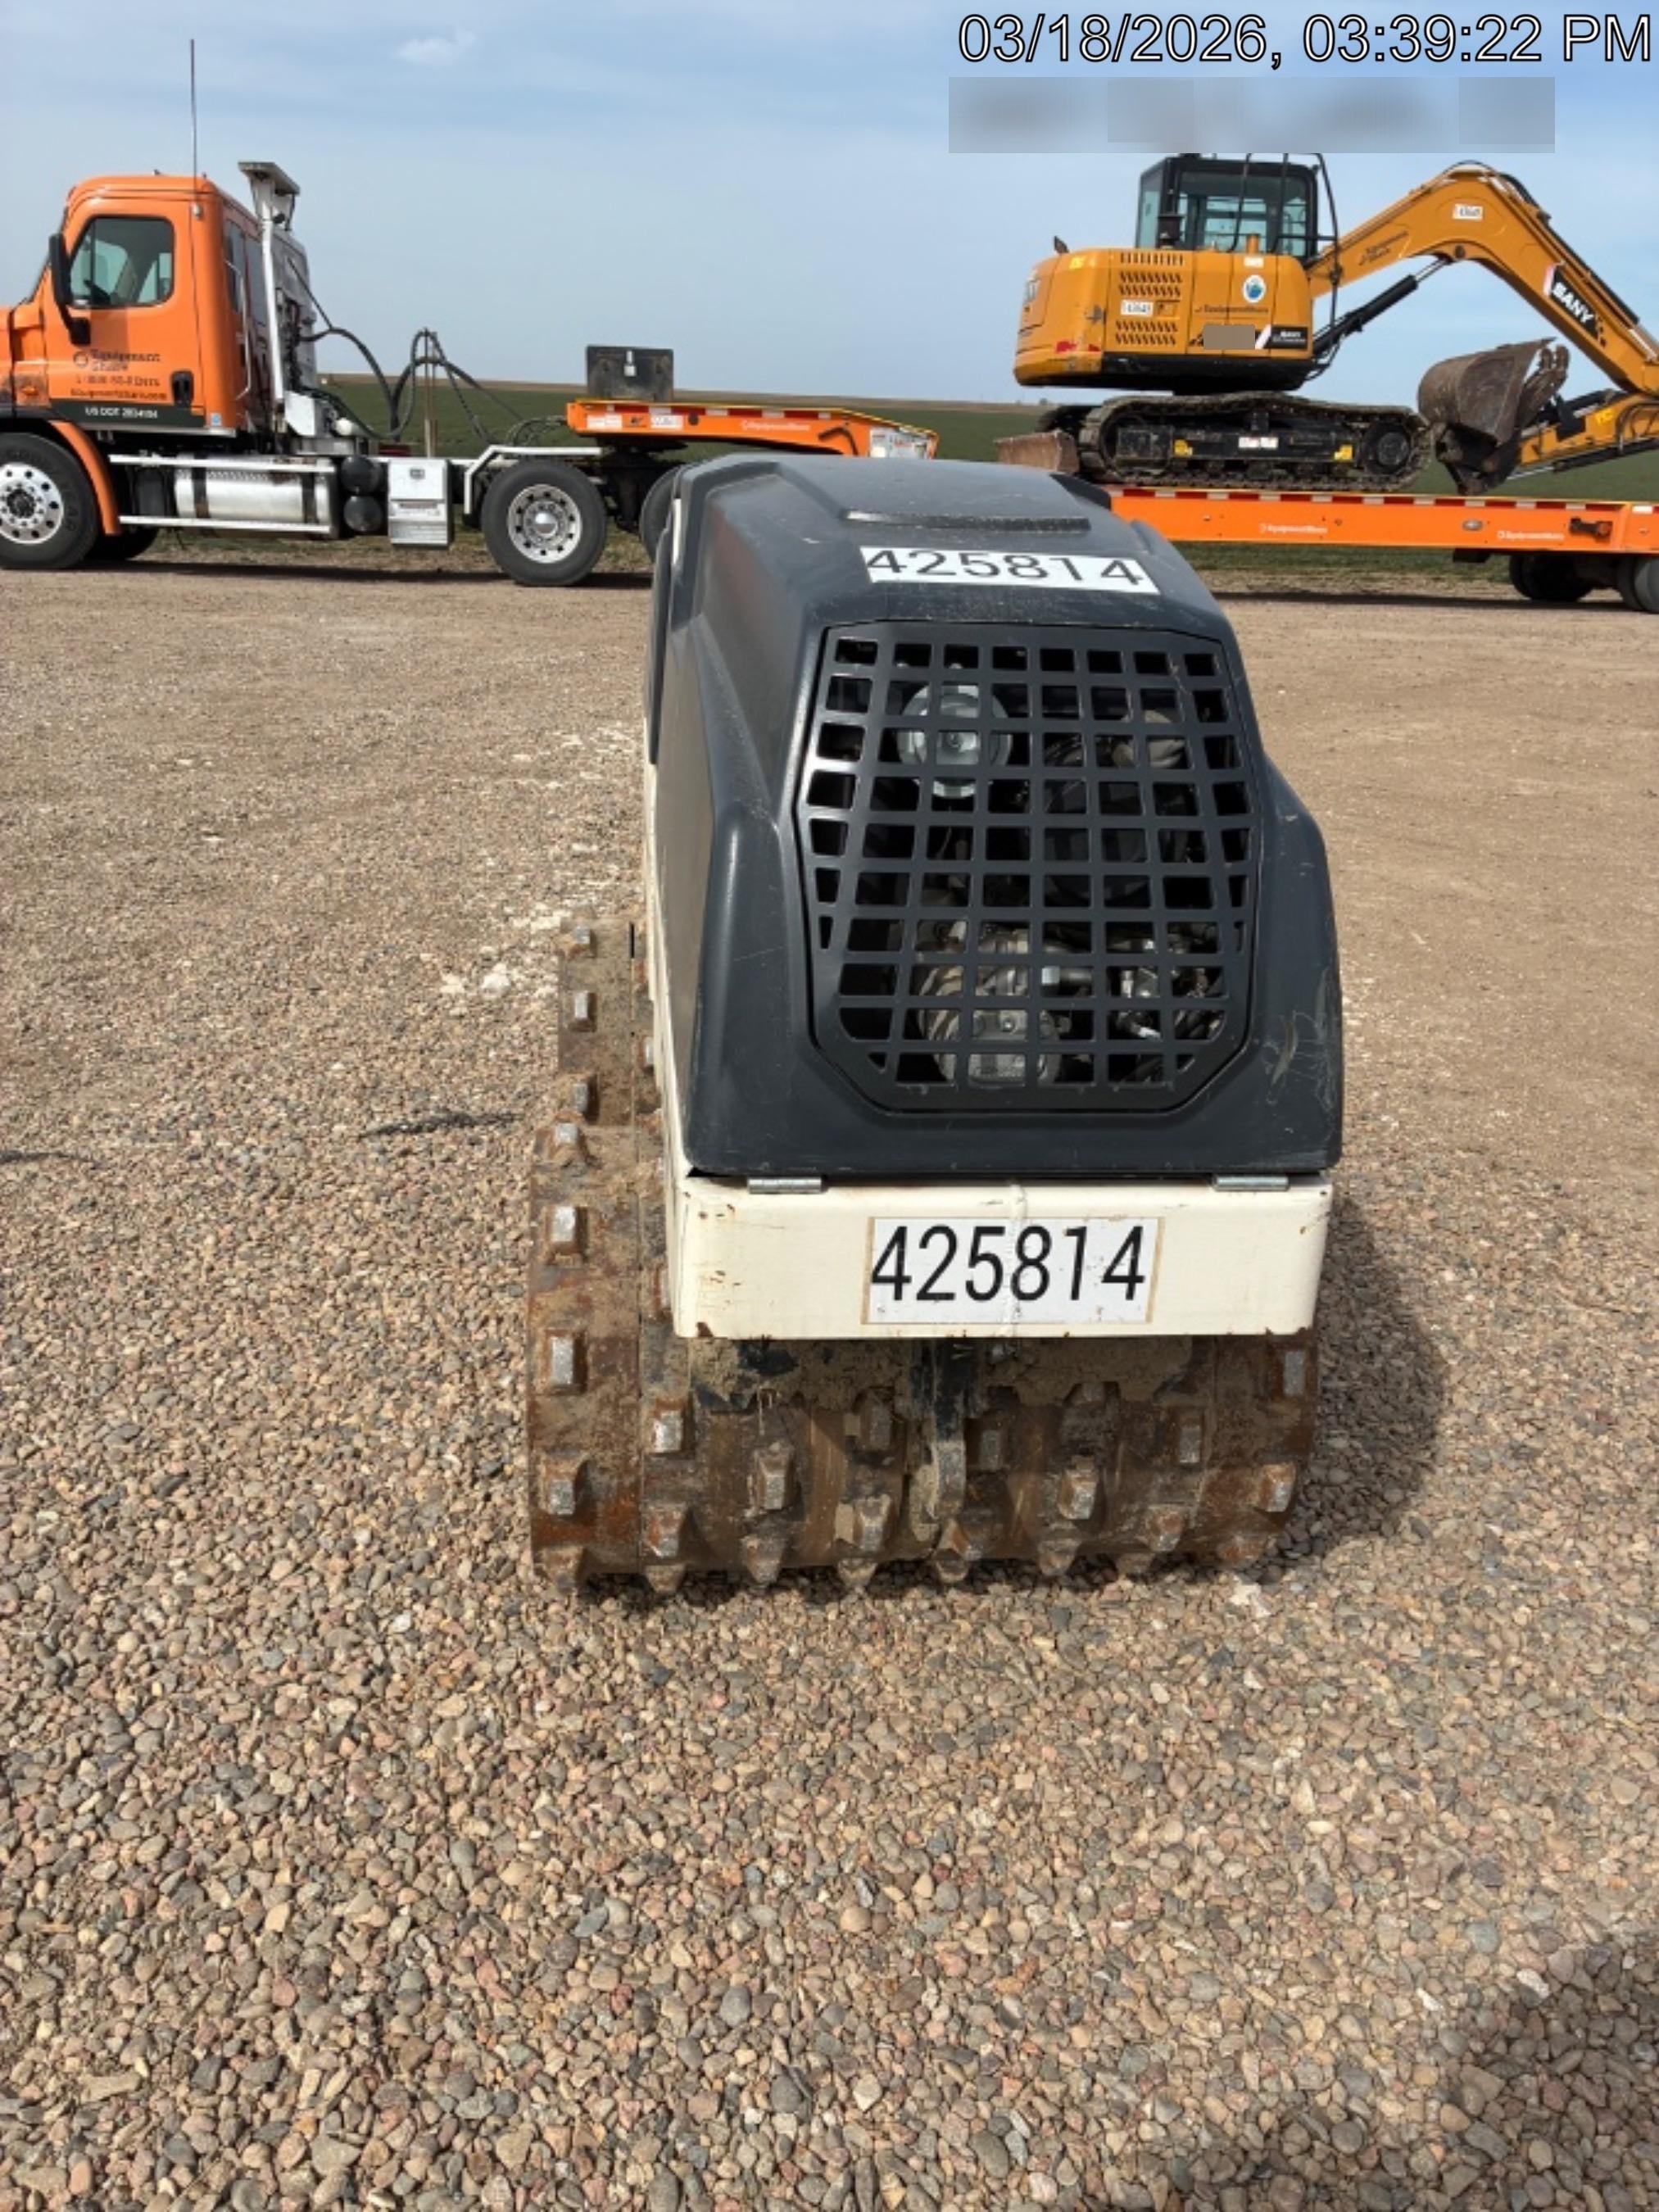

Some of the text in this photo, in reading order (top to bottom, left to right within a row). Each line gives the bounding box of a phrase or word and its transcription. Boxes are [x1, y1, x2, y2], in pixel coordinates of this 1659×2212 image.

[1552, 281, 1593, 323] SANY
[866, 549, 1144, 585] 425814
[871, 1225, 1147, 1301] 425814
